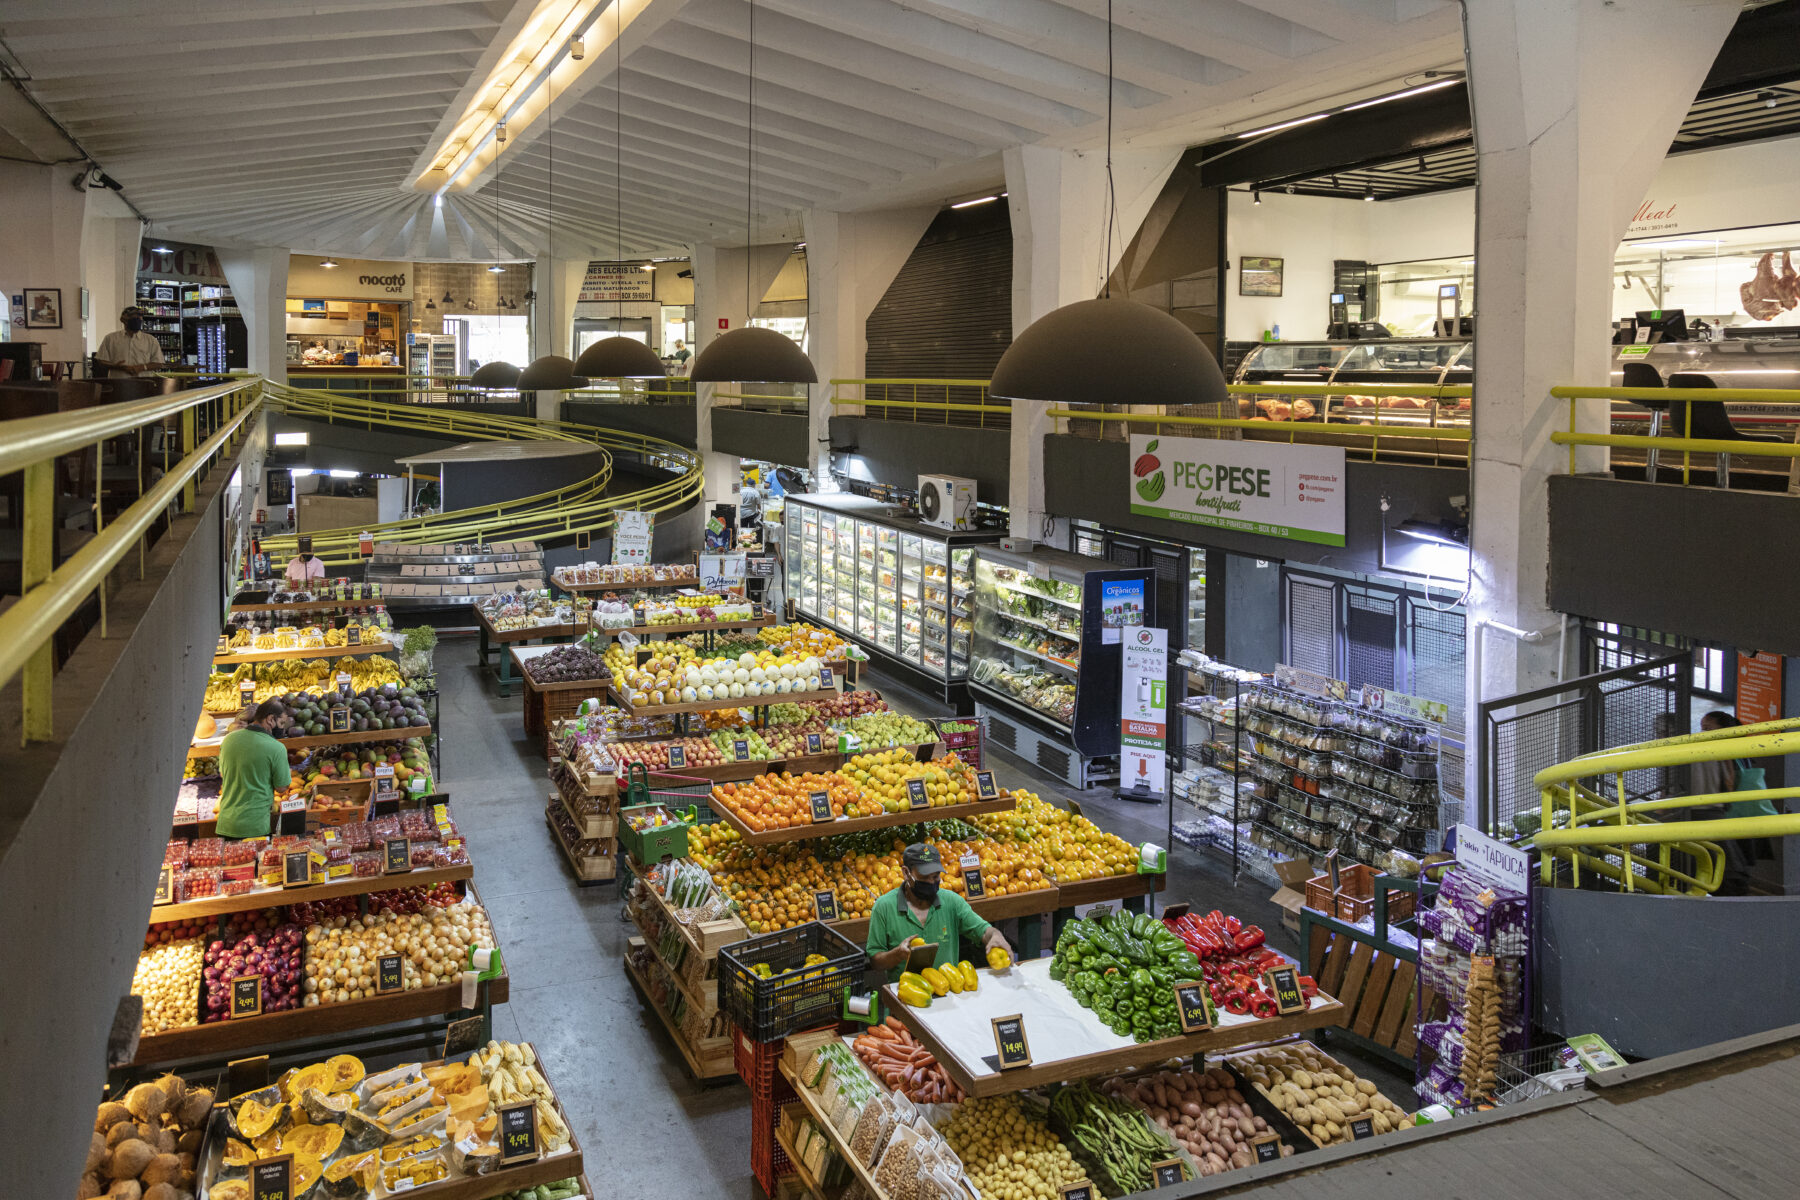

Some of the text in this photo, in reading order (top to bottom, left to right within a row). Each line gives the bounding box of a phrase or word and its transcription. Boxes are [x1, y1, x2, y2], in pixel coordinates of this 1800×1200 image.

[359, 273, 406, 286] mocotó
[1173, 461, 1271, 498] PEGPESE
[1195, 492, 1242, 514] hortifruti
[1169, 511, 1191, 520] MERCADO
[1192, 514, 1217, 525] MUNICIPAL
[1218, 518, 1226, 527] DE
[1226, 519, 1254, 531] PINHEIROS
[1258, 525, 1270, 533] BOX
[283, 801, 304, 809] OFERTA
